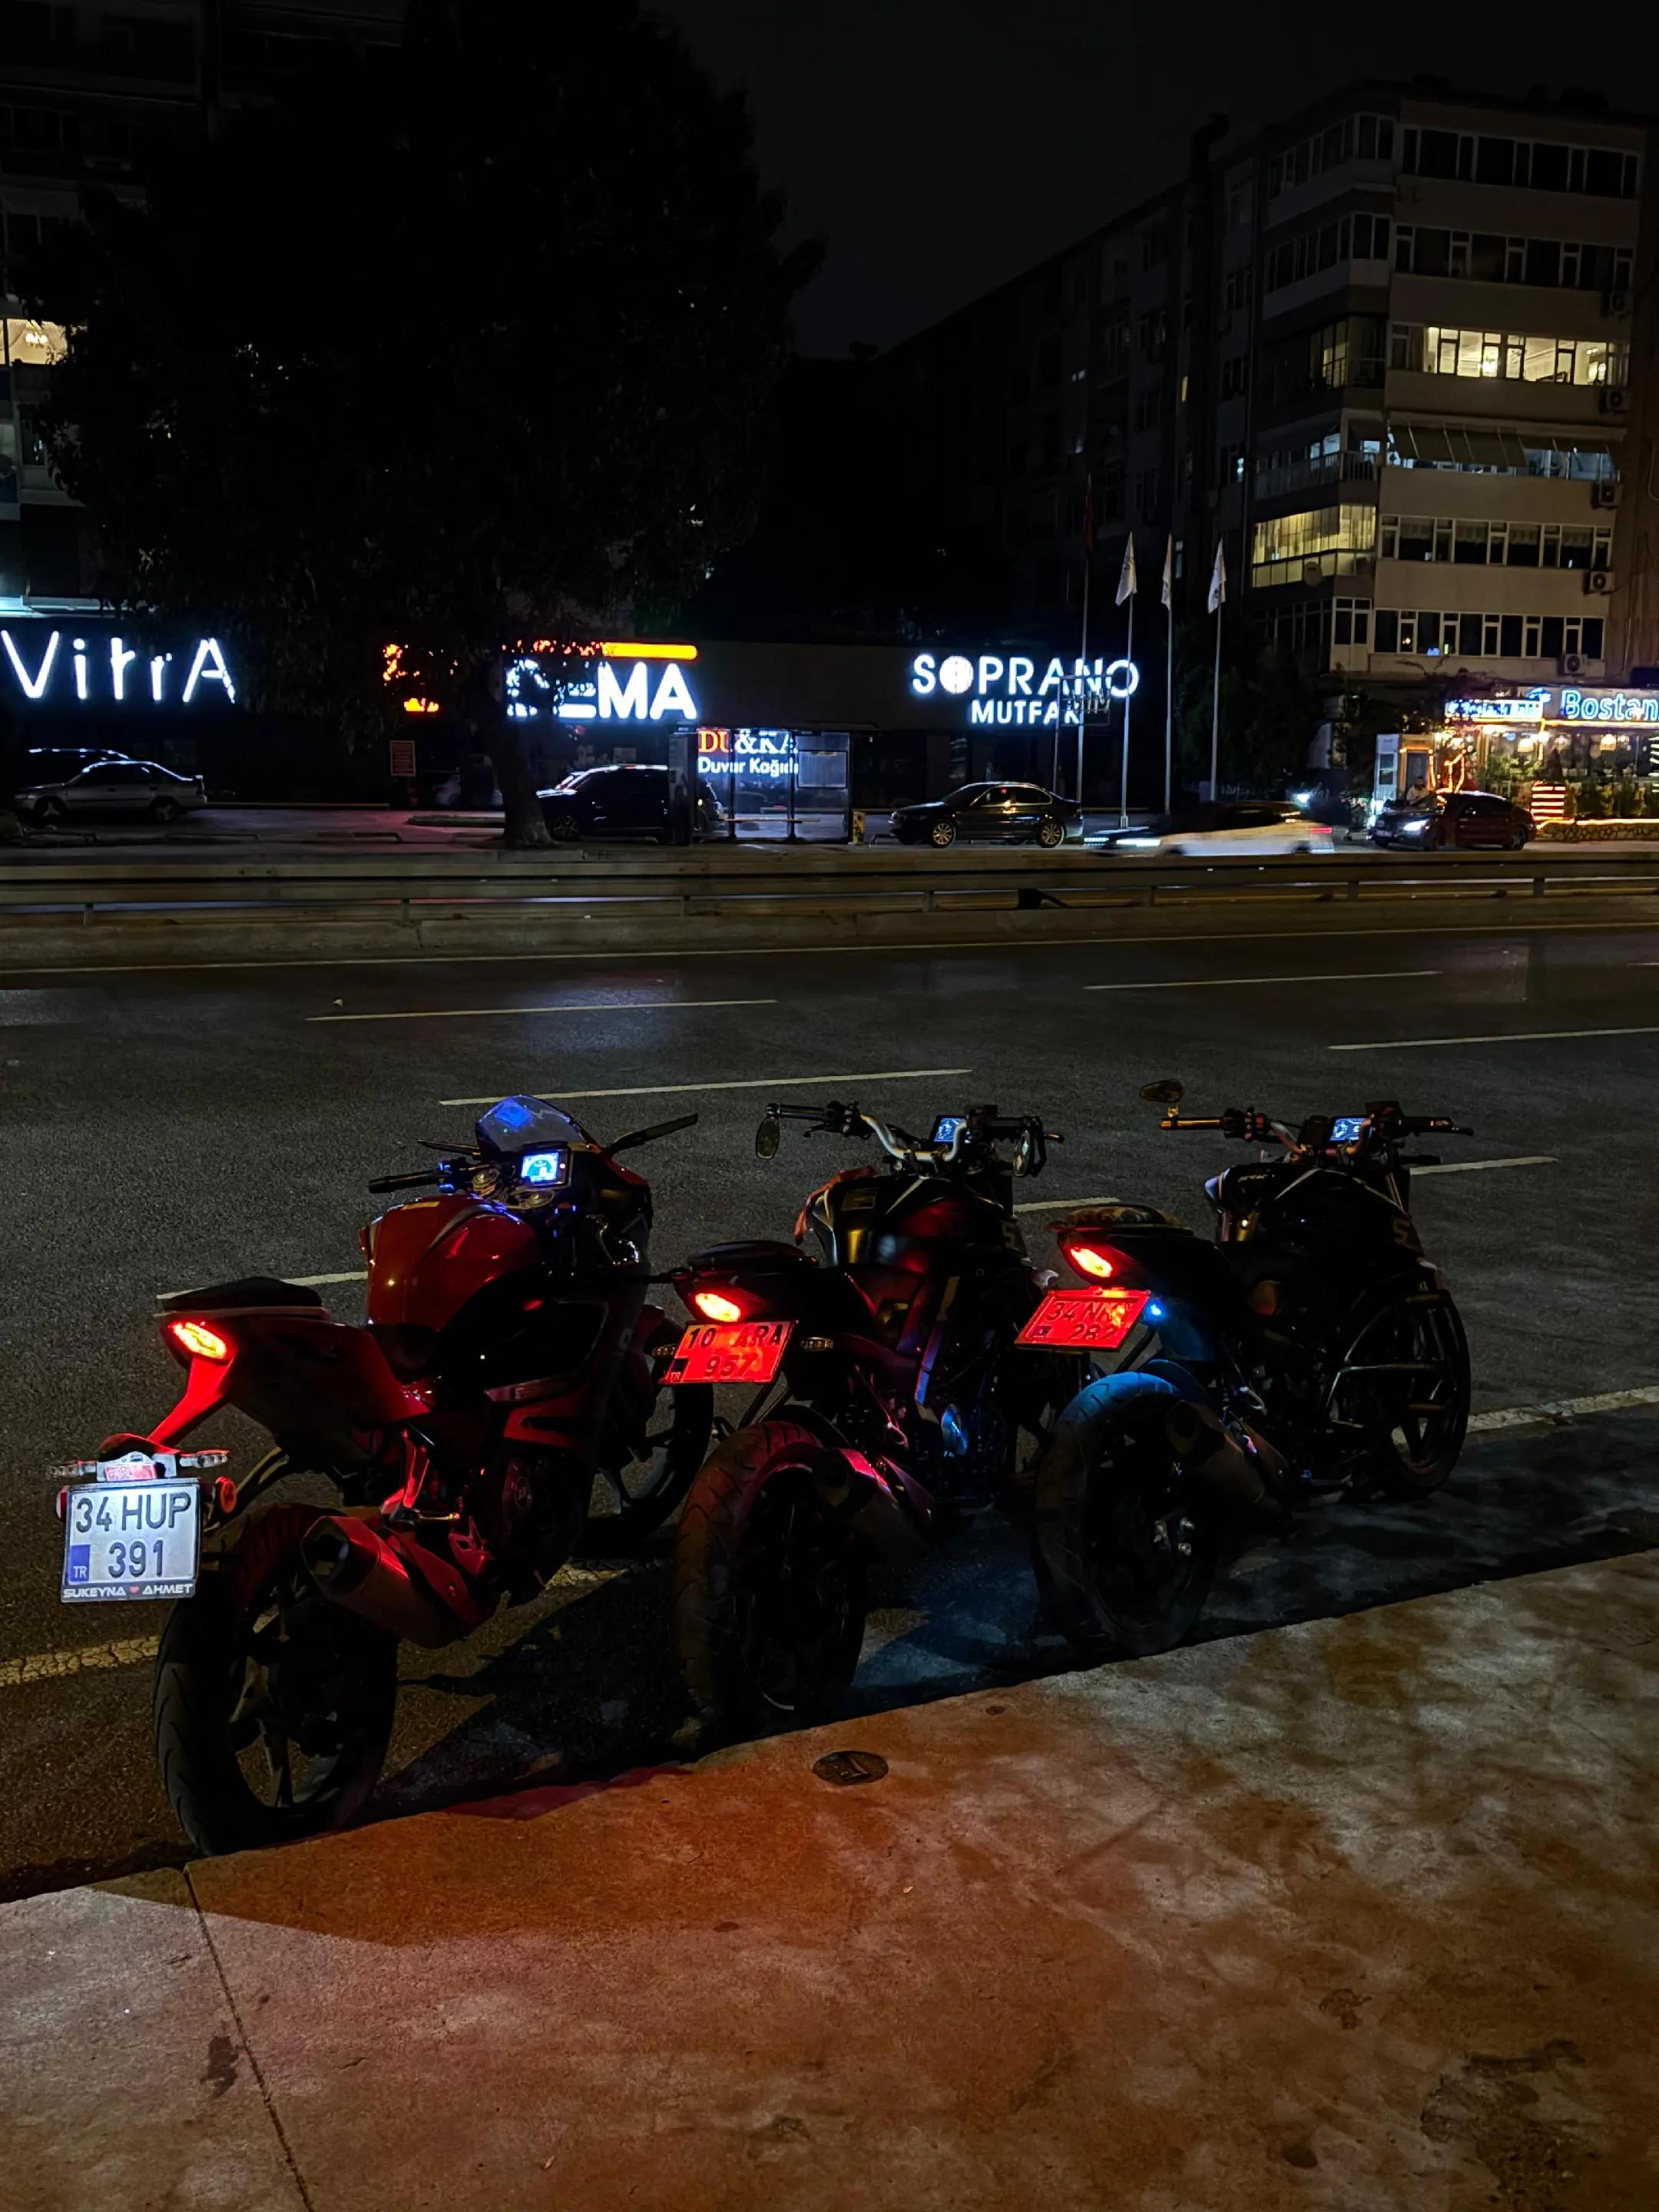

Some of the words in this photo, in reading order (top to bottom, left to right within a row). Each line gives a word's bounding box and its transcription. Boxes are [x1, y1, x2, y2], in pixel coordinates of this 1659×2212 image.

[912, 653, 1141, 697] SOPRANO
[971, 700, 1081, 725] MUTFAK
[1561, 690, 1659, 721] Bostan
[689, 1327, 717, 1349] 10
[75, 1496, 113, 1533] 34
[121, 1492, 191, 1531] HUP
[73, 1565, 88, 1579] TR
[108, 1539, 164, 1578] 391
[63, 1585, 127, 1598] SUKEYNA
[141, 1583, 193, 1595] AHMET
